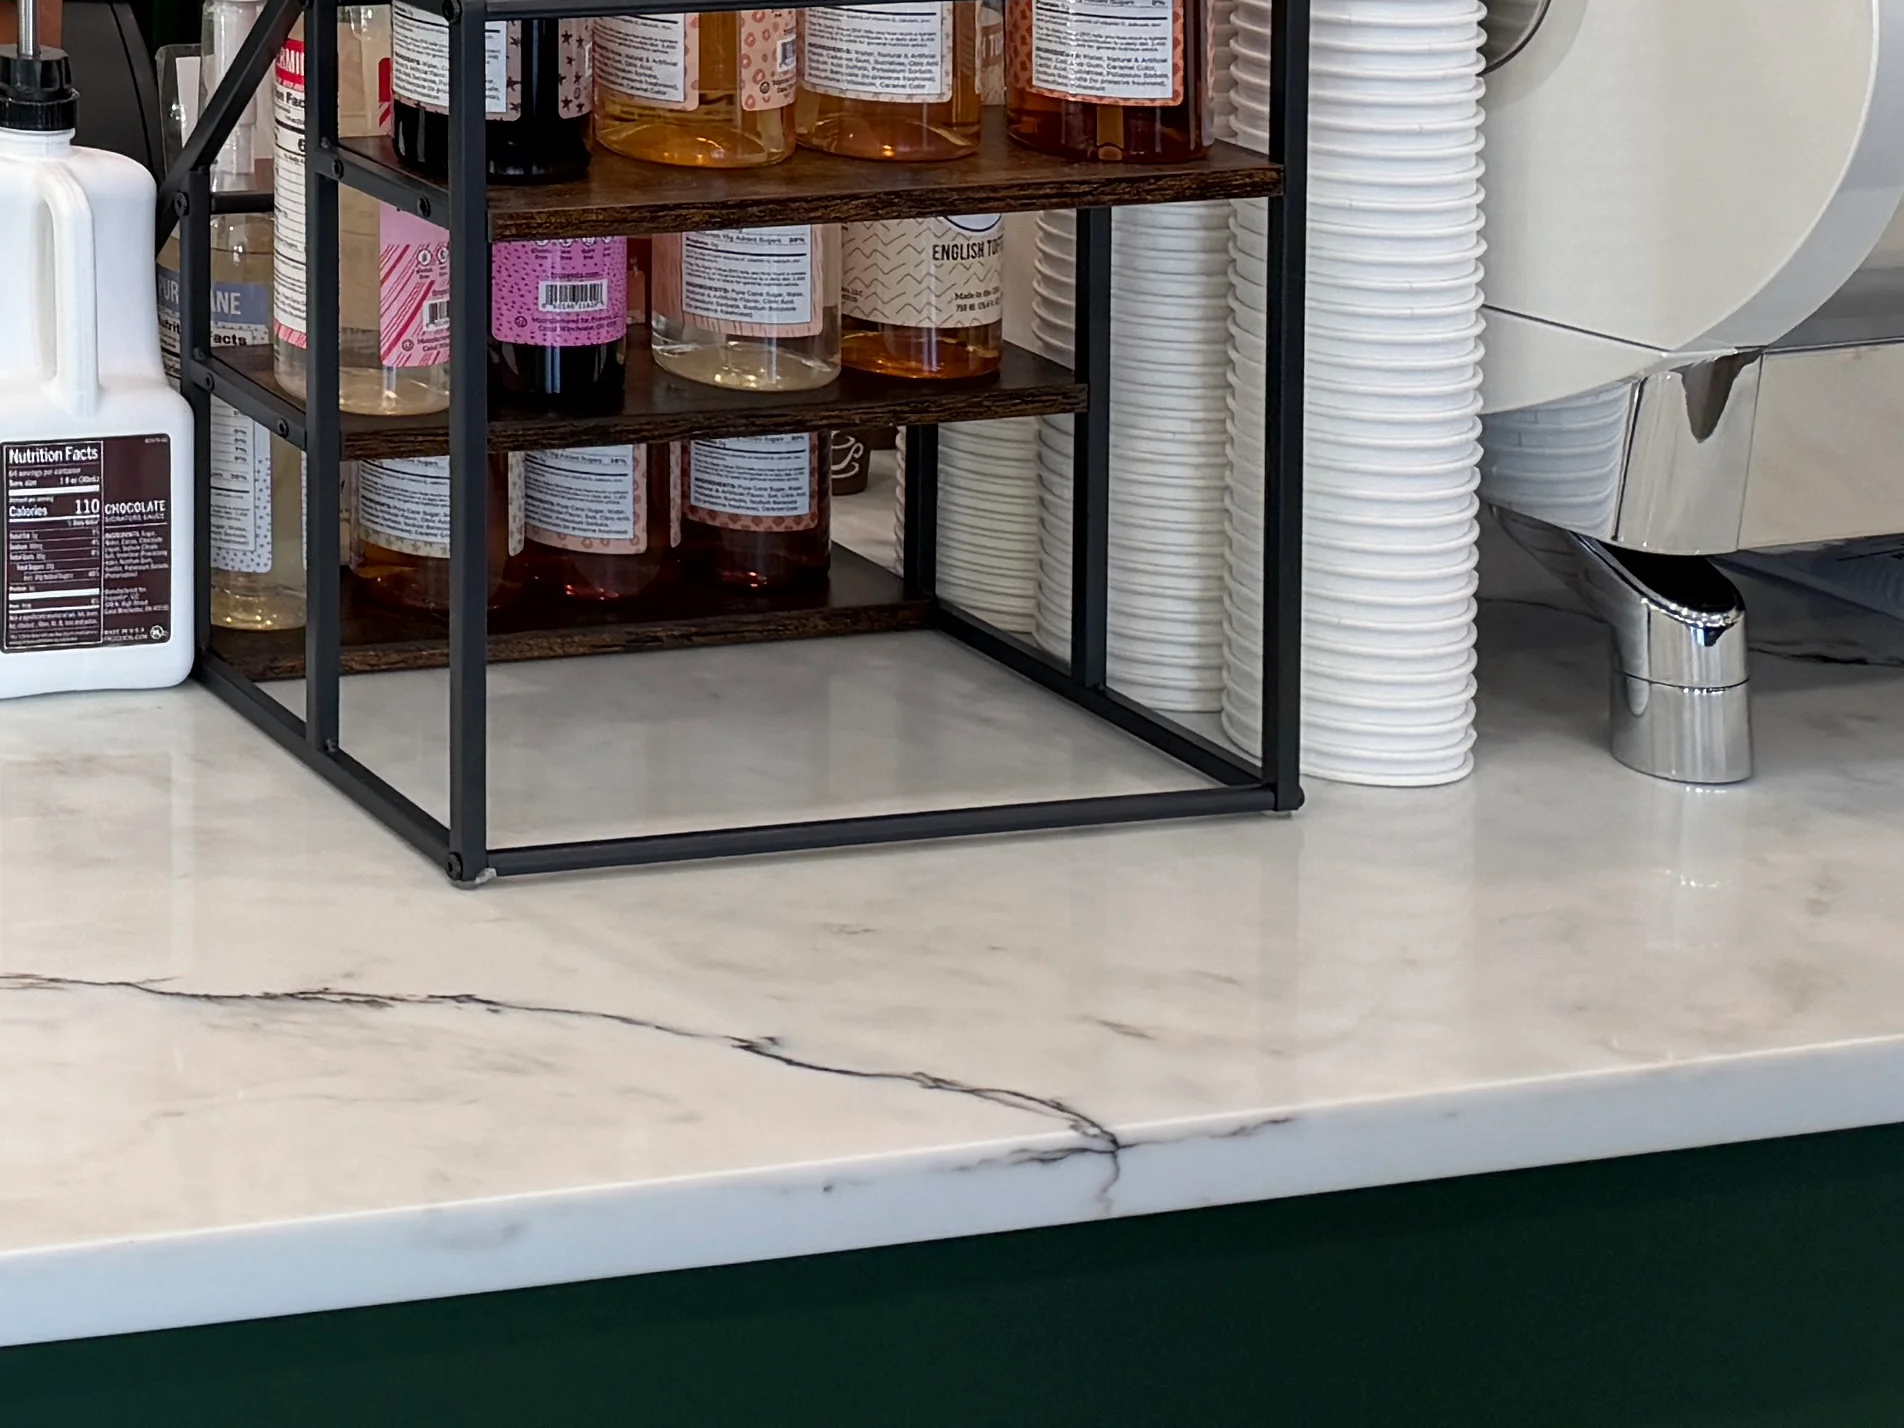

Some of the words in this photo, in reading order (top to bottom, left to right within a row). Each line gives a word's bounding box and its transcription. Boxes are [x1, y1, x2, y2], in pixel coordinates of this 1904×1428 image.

[932, 241, 985, 261] ENGLISH
[8, 449, 65, 465] Nutrition
[65, 446, 98, 462] Facts
[74, 498, 100, 515] 110
[104, 499, 166, 515] CHOCOLATE
